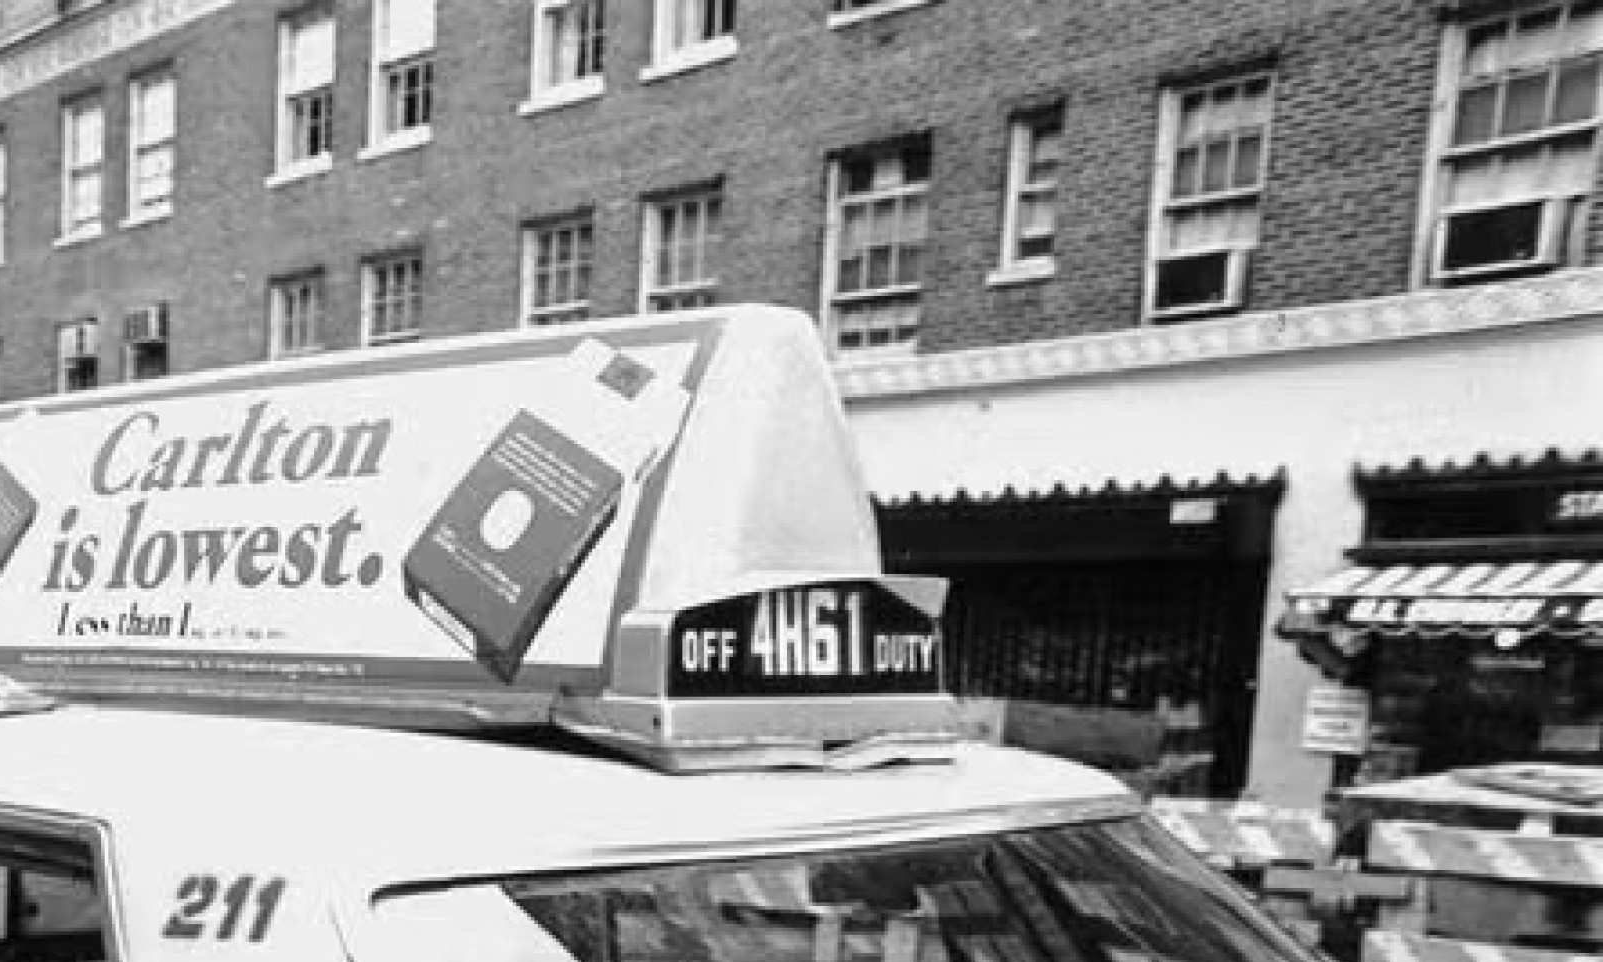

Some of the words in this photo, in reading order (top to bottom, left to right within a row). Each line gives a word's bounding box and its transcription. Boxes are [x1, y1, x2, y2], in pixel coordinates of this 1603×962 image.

[91, 399, 391, 496] Carlton
[43, 505, 101, 593] is
[105, 498, 384, 590] lowest.
[681, 630, 737, 672] OFF
[751, 588, 863, 676] 4H61
[873, 634, 933, 672] DUTY
[161, 875, 287, 942] 211
